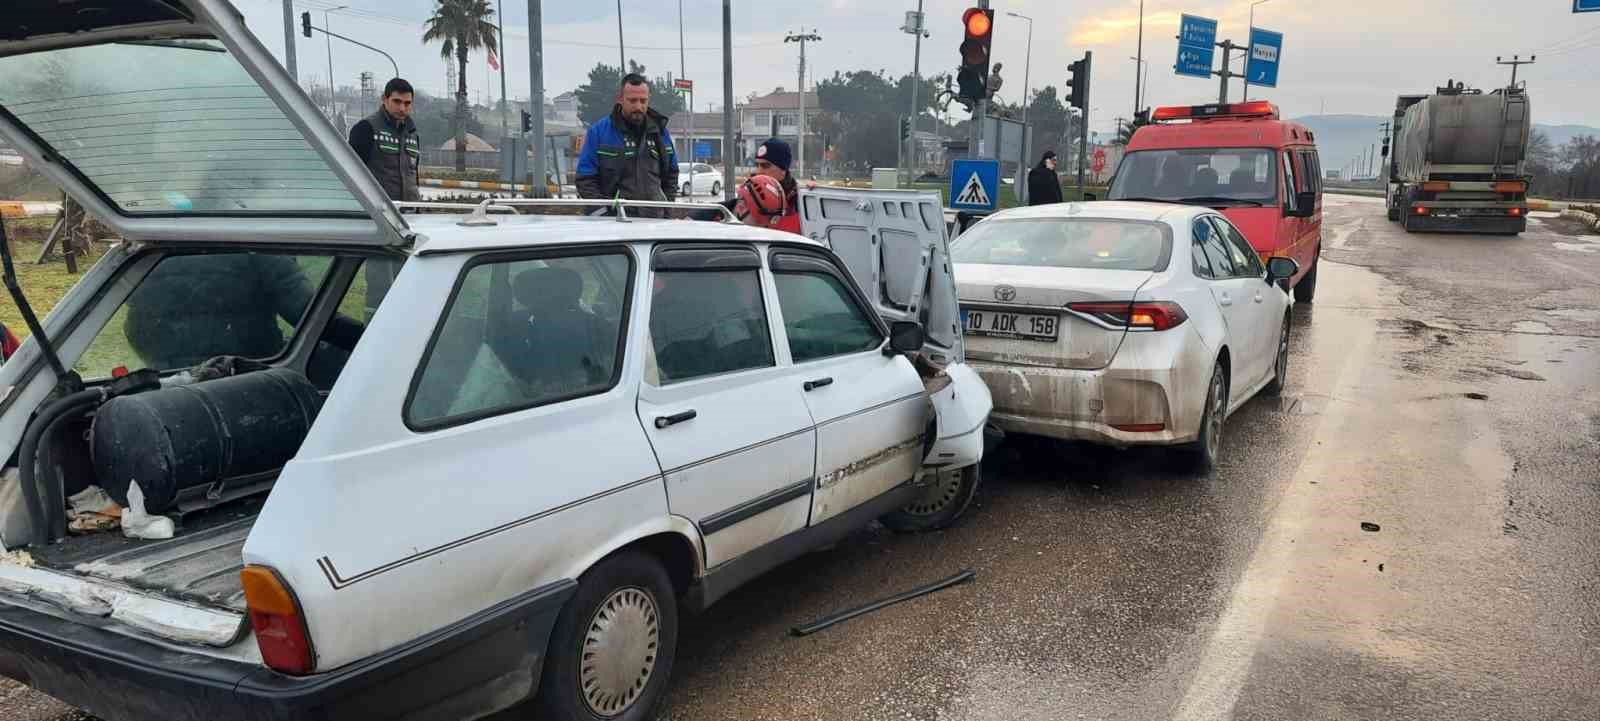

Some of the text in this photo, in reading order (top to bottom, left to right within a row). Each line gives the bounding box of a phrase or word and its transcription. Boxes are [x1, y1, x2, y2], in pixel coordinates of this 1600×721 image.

[968, 312, 1054, 335] 10 ADK 158
